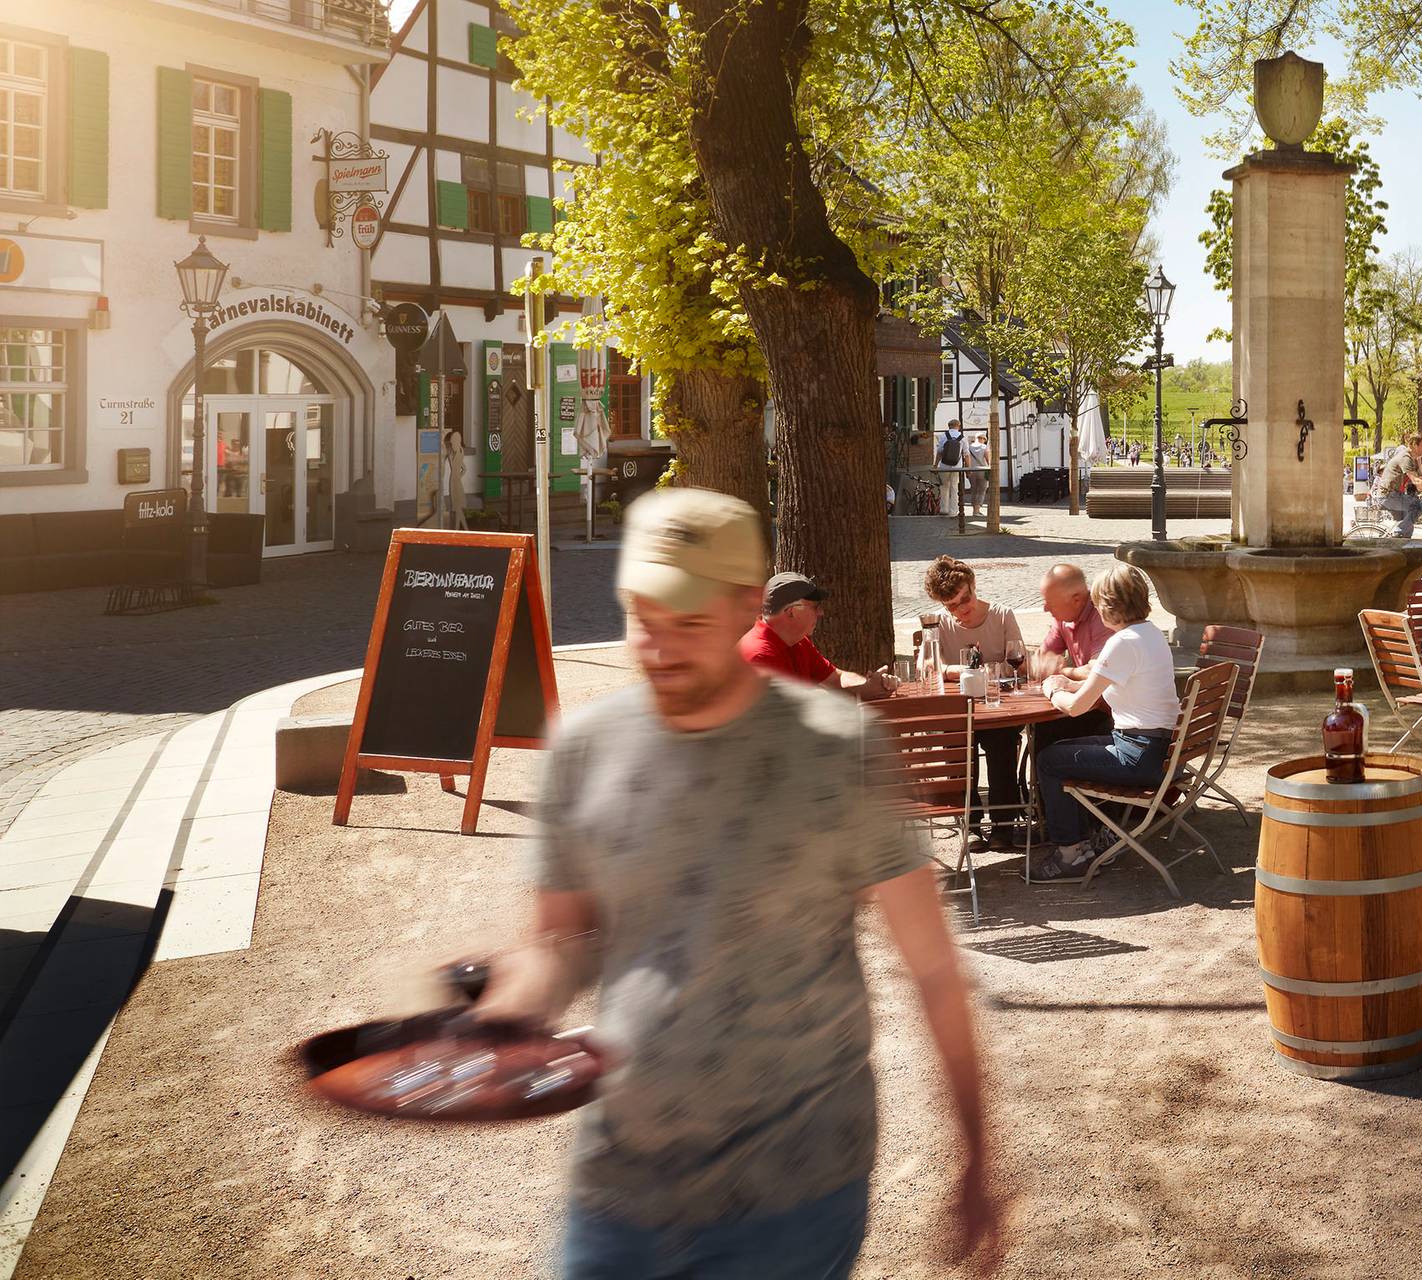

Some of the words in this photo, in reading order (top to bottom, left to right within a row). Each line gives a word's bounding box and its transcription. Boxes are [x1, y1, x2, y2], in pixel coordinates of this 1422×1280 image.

[333, 165, 382, 183] Spielmann
[208, 294, 354, 343] arnevalskabinett
[387, 324, 421, 334] GUINNESS
[120, 411, 134, 425] 21
[138, 501, 174, 519] fritz-kola
[402, 619, 435, 632] GUTES
